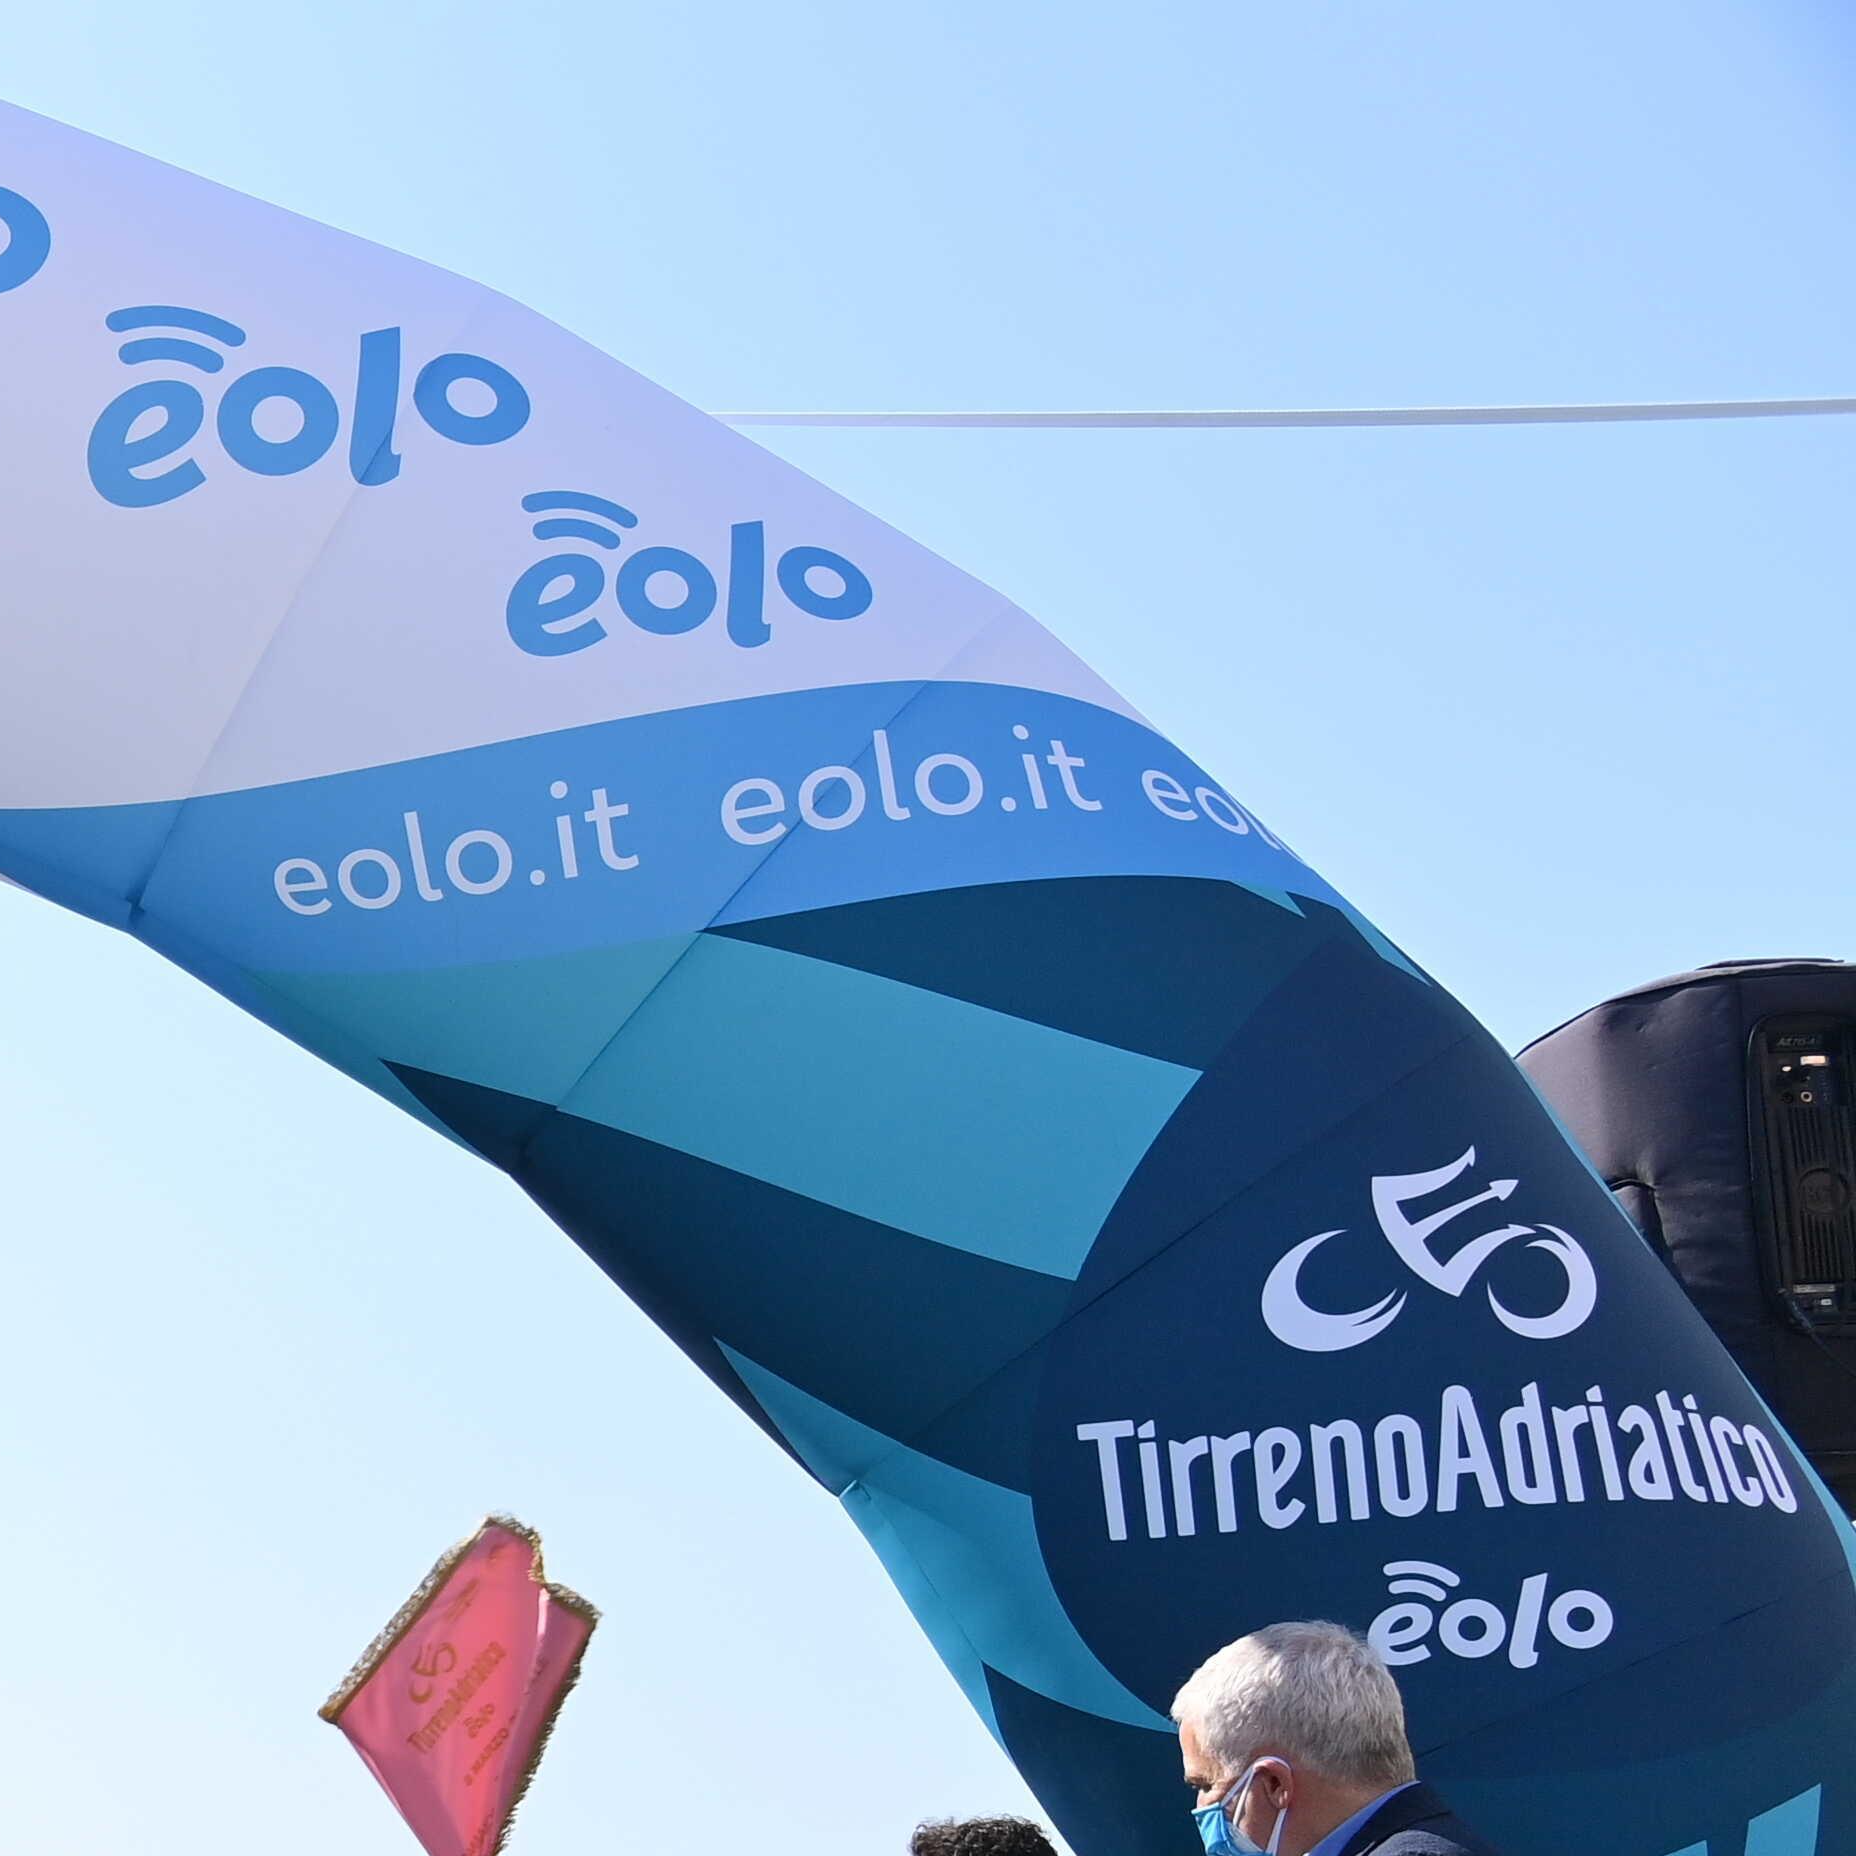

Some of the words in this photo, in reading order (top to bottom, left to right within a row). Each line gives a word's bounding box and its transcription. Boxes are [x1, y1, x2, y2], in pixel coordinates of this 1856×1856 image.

[88, 315, 531, 508] eolo
[506, 505, 874, 657] eolo
[273, 780, 640, 917] eolo.it
[721, 724, 1102, 847] eolo.it
[1077, 1380, 1798, 1542] TirrenoAdriatico
[1366, 1570, 1615, 1669] eolo
